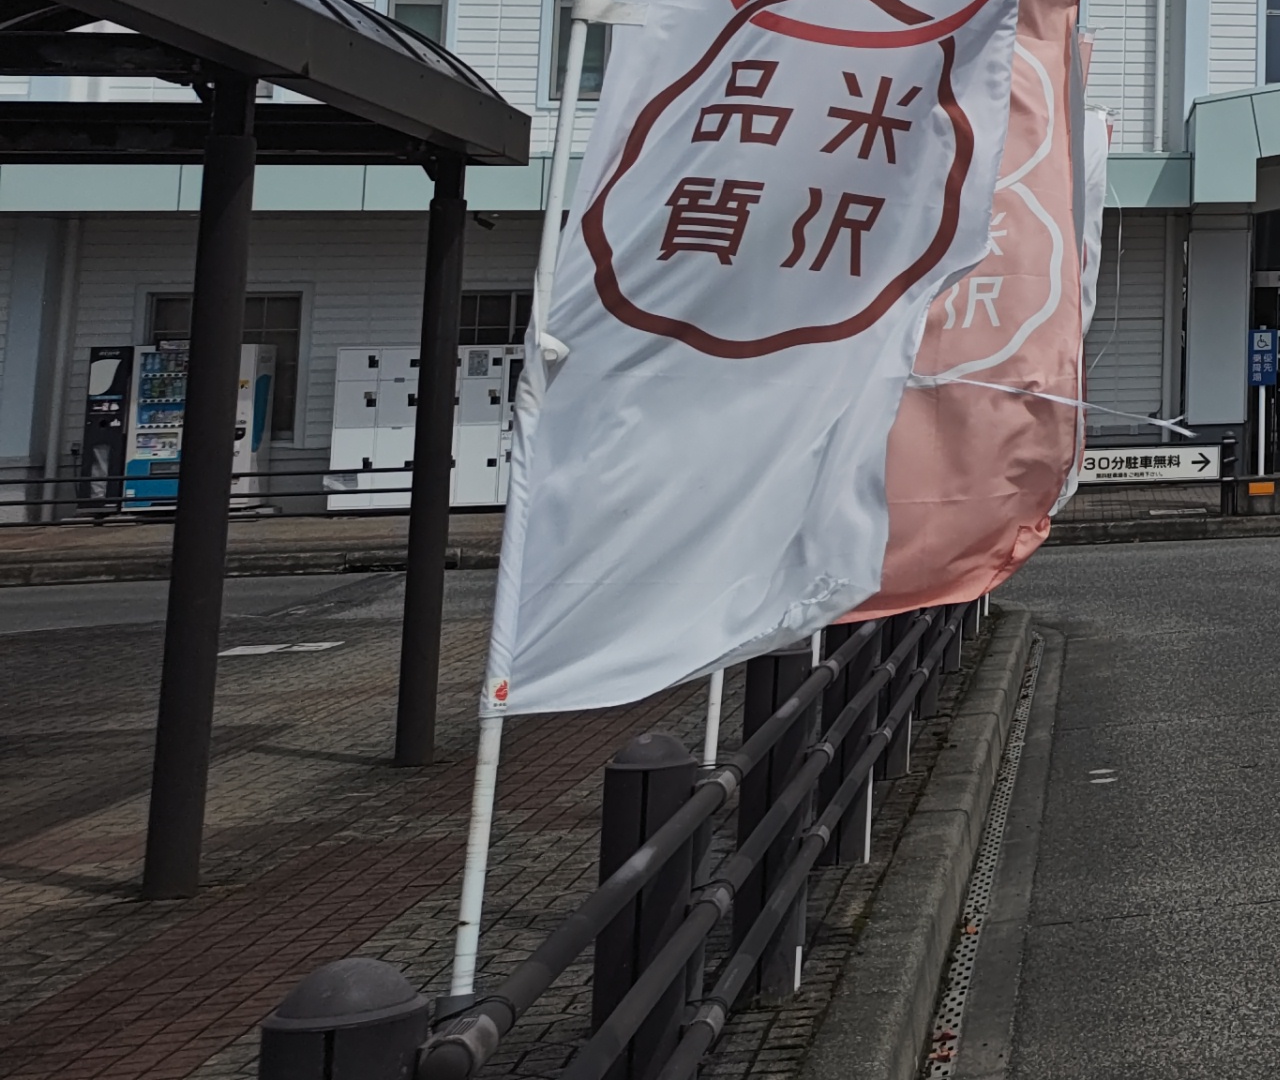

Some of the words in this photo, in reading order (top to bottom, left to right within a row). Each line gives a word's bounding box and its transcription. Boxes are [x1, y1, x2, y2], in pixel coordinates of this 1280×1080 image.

[655, 59, 794, 266] 品質
[780, 70, 924, 277] 米沢
[1083, 455, 1181, 470] 30分駐車無料
